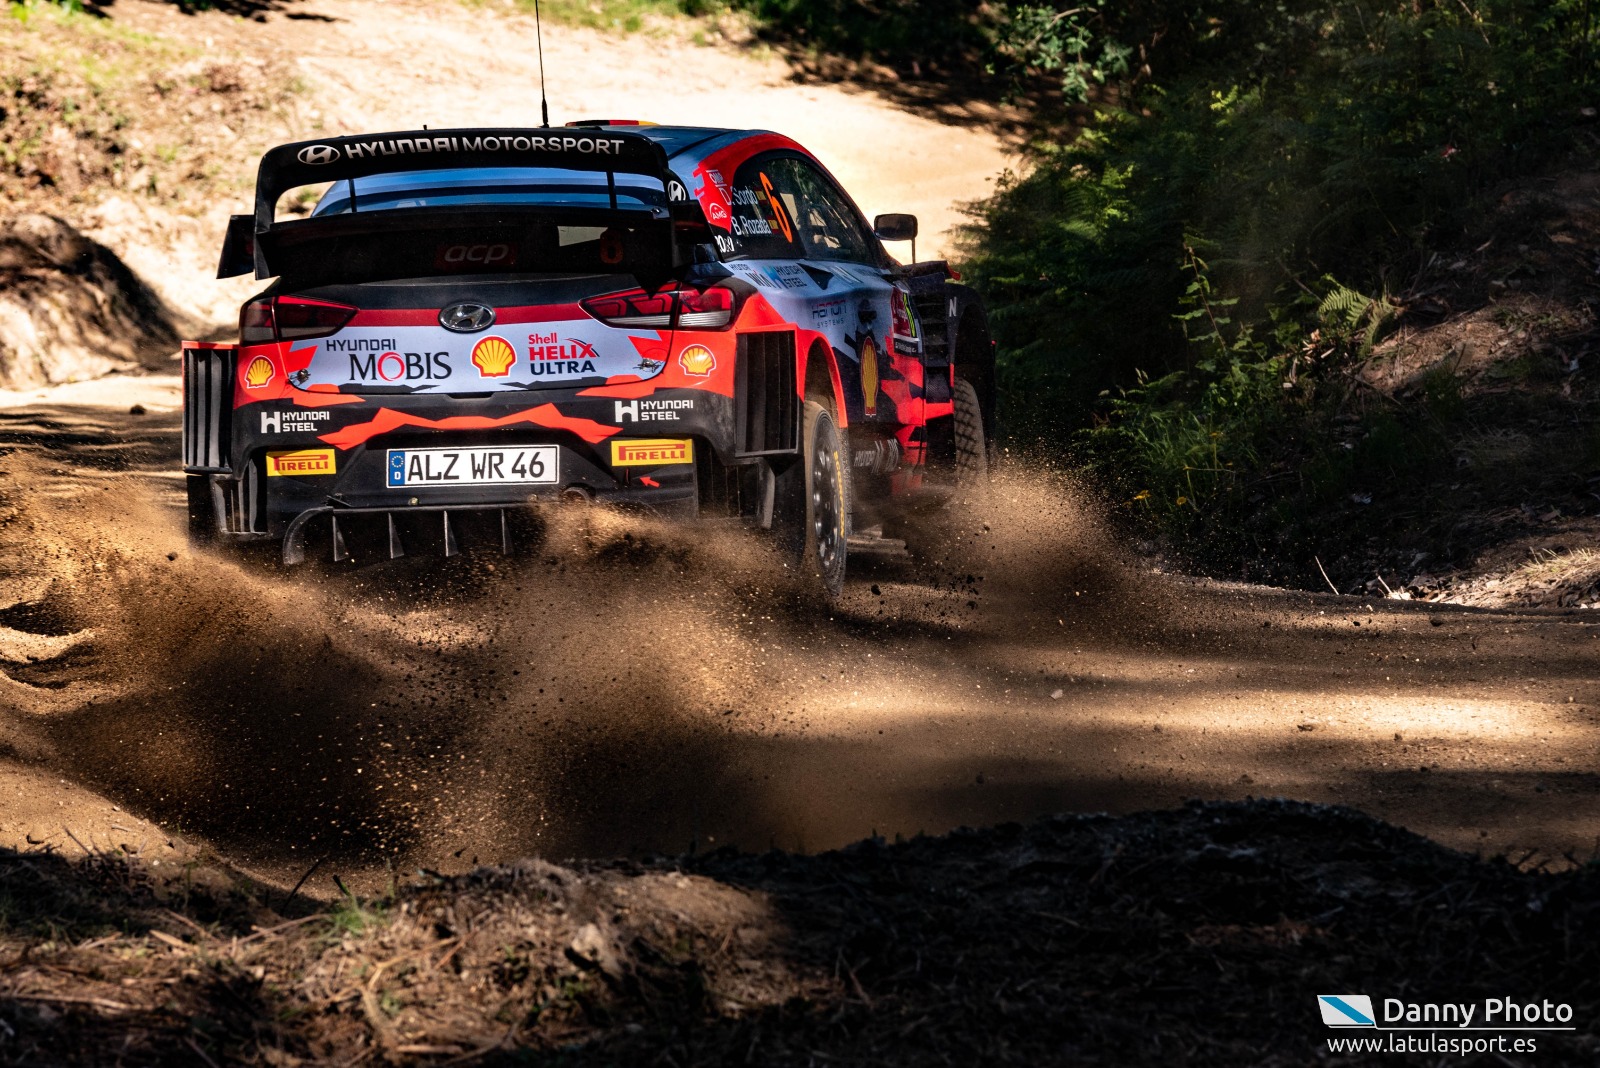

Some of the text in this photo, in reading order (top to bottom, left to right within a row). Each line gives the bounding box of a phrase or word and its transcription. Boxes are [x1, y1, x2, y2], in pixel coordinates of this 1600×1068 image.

[345, 135, 625, 160] HYUNDAI MOTORSPORT
[758, 171, 793, 244] 6
[444, 243, 510, 265] acp
[783, 277, 808, 288] STEEL
[948, 296, 958, 318] N
[326, 338, 396, 351] HYUNDAI
[528, 332, 558, 345] Shell
[528, 342, 597, 361] HELIX
[349, 351, 452, 381] MOBIS
[530, 360, 597, 376] ULTRA
[640, 399, 694, 411] HYUNDAI
[282, 411, 331, 422] HYUNDAI
[640, 410, 681, 421] STEEL
[282, 421, 318, 433] STEEL
[617, 443, 686, 461] PIRELLI
[273, 454, 330, 472] PIRELLI
[406, 450, 545, 483] ALZ WR 46
